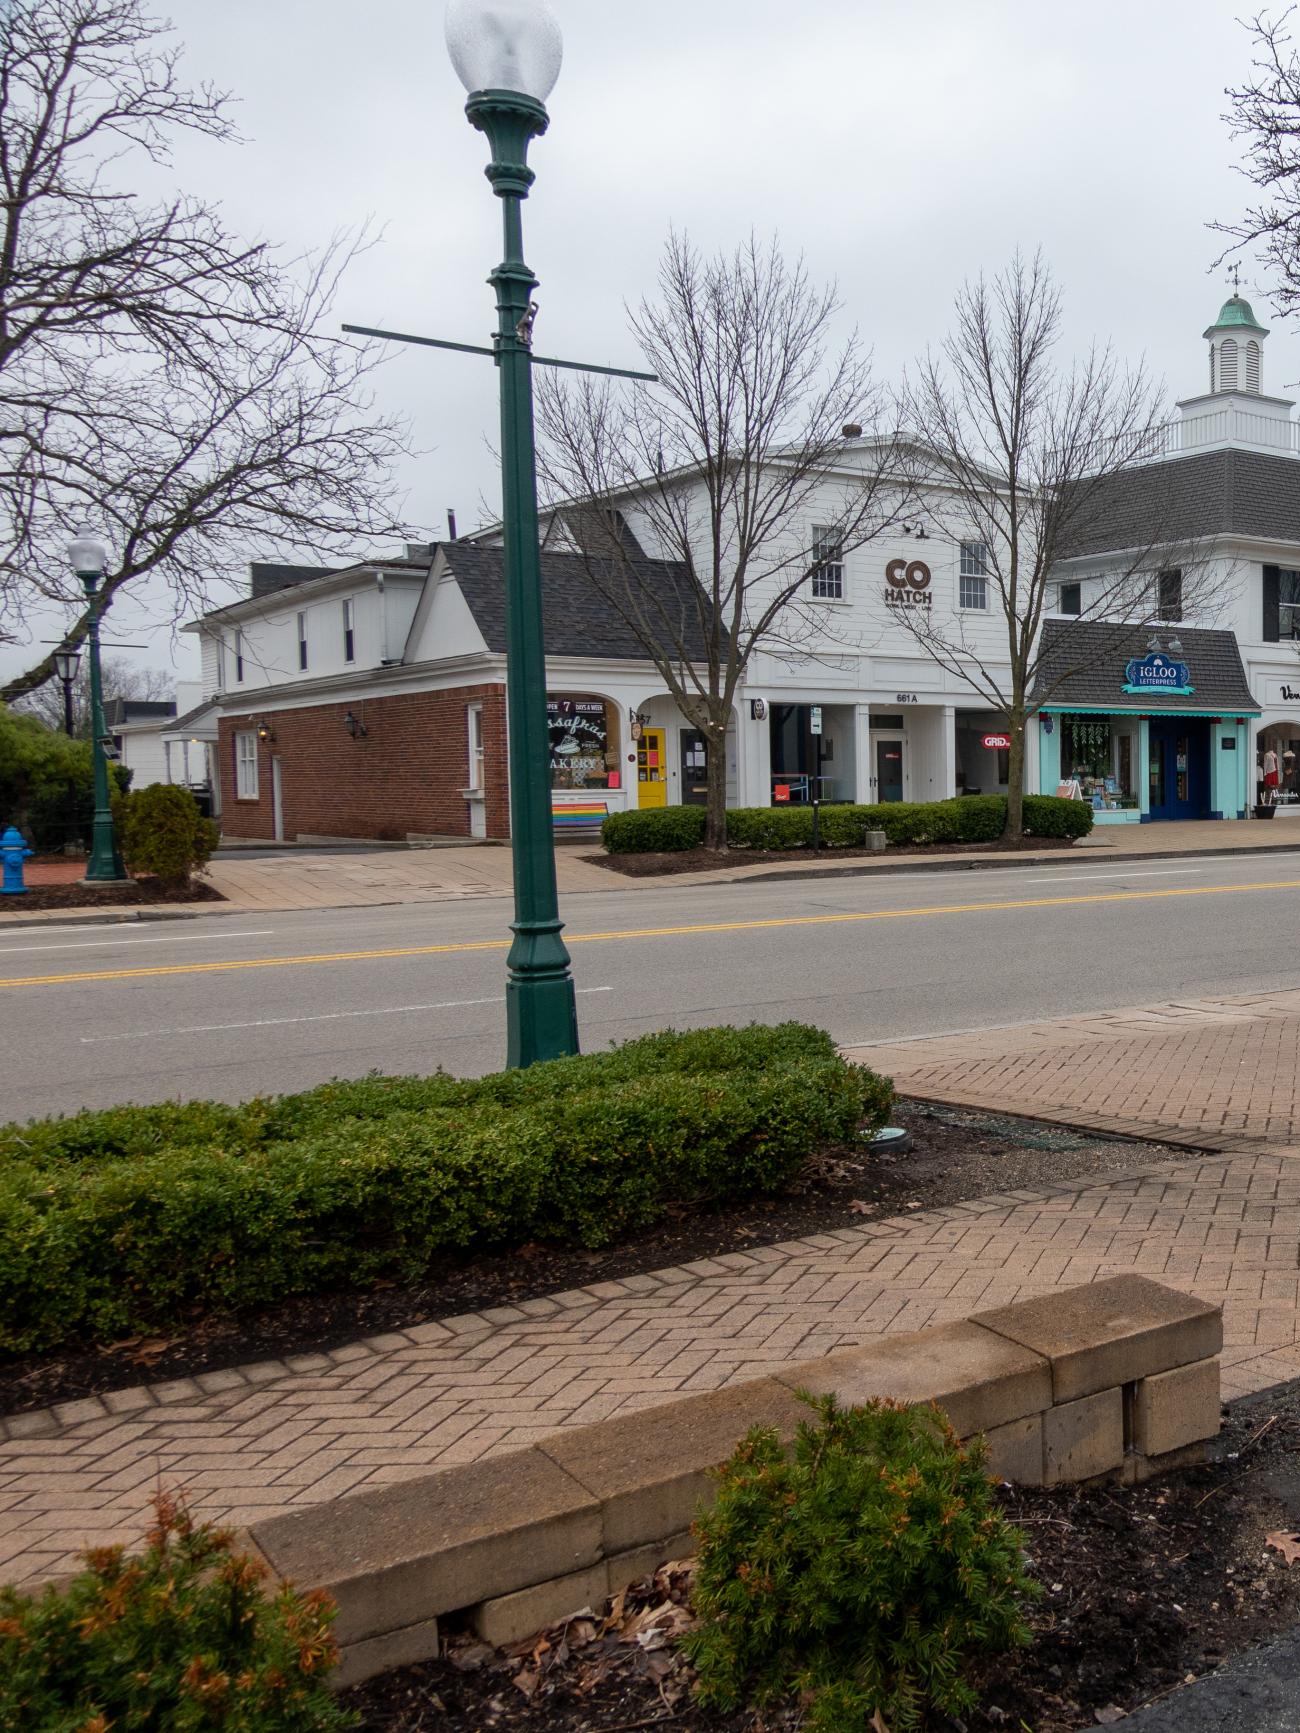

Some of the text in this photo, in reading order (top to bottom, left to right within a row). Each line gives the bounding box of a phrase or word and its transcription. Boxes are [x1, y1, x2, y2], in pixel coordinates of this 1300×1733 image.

[885, 558, 932, 591] CO
[884, 588, 932, 604] HATCH
[1139, 678, 1177, 686] LETTERPRESS
[896, 693, 918, 703] 661 A
[563, 701, 571, 712] 7
[547, 716, 607, 740] ssafras
[984, 736, 1006, 747] GRID
[549, 758, 597, 769] AKERY
